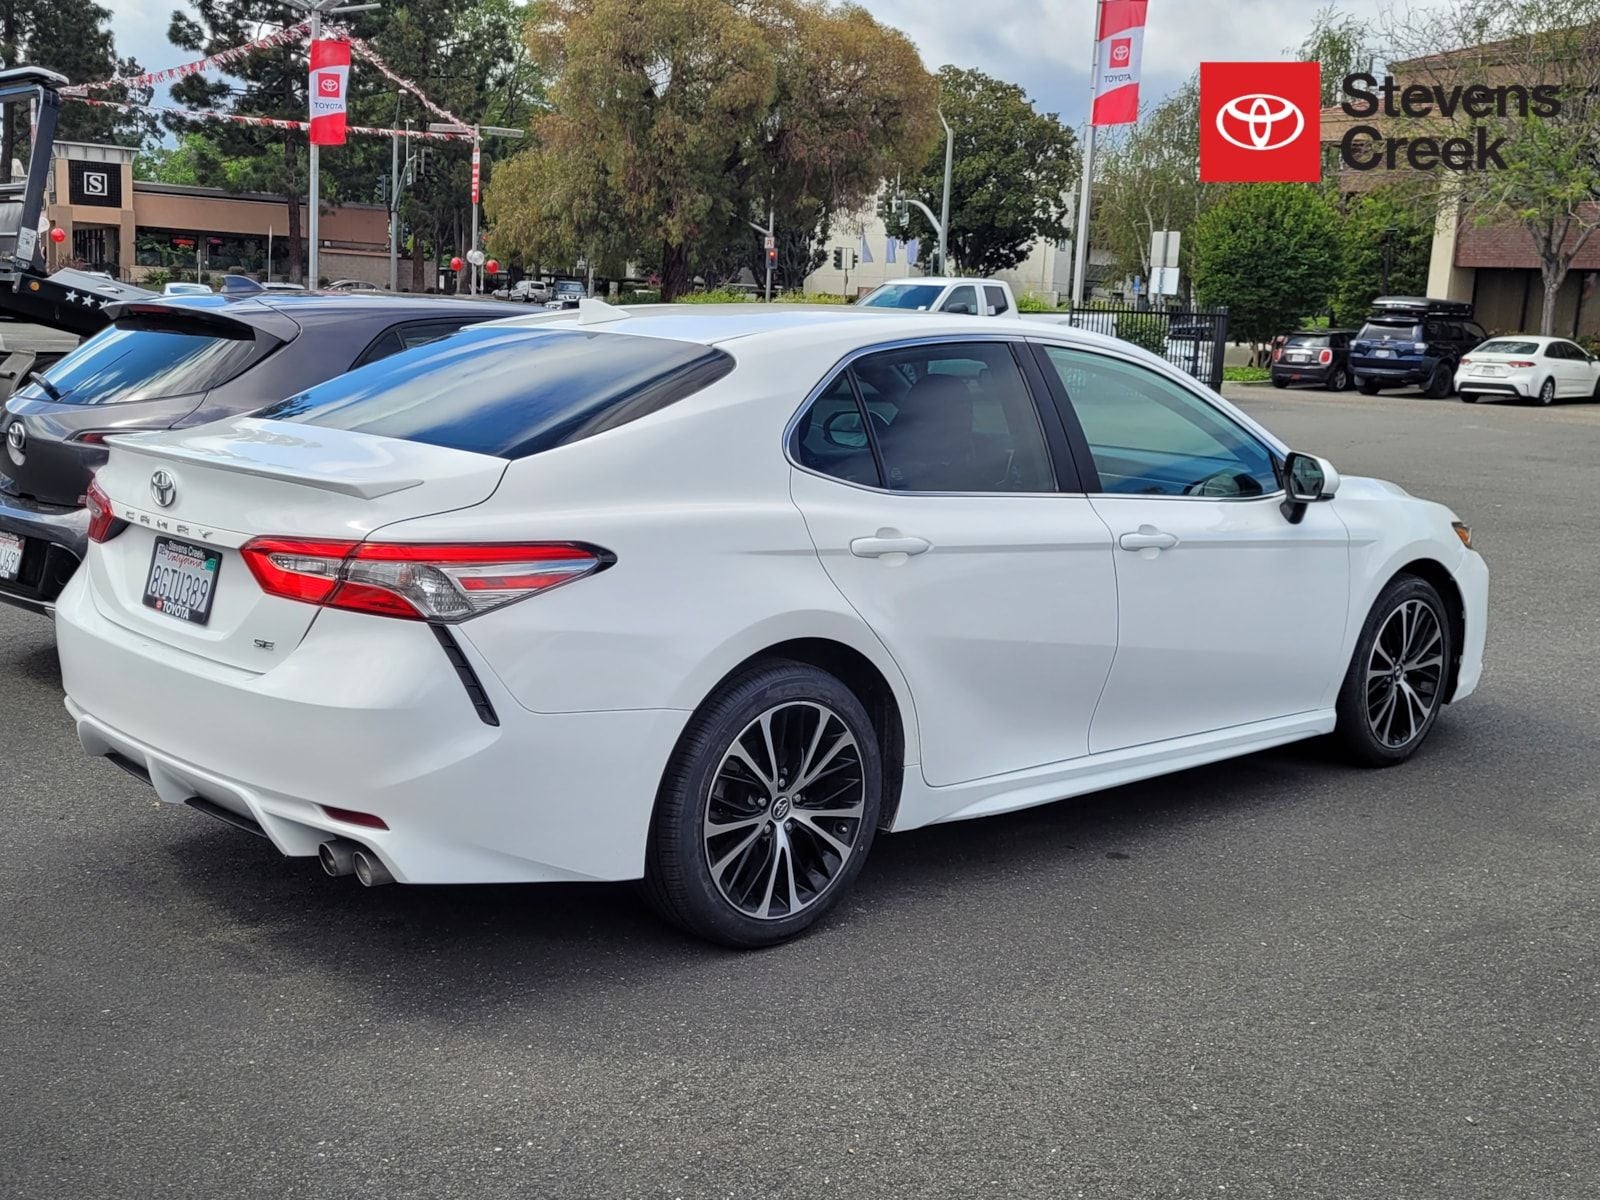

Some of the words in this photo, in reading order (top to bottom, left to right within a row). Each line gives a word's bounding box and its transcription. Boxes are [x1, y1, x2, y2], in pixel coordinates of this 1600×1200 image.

[1104, 73, 1132, 83] TOYOTA
[314, 102, 343, 110] TOYOTA
[88, 175, 103, 192] S
[126, 511, 213, 539] CAMRY
[168, 540, 189, 555] Stevens
[187, 546, 206, 561] Creek
[167, 552, 202, 569] California
[151, 565, 208, 609] 8GIU389
[163, 600, 190, 619] TOYOTA
[253, 639, 275, 651] SE
